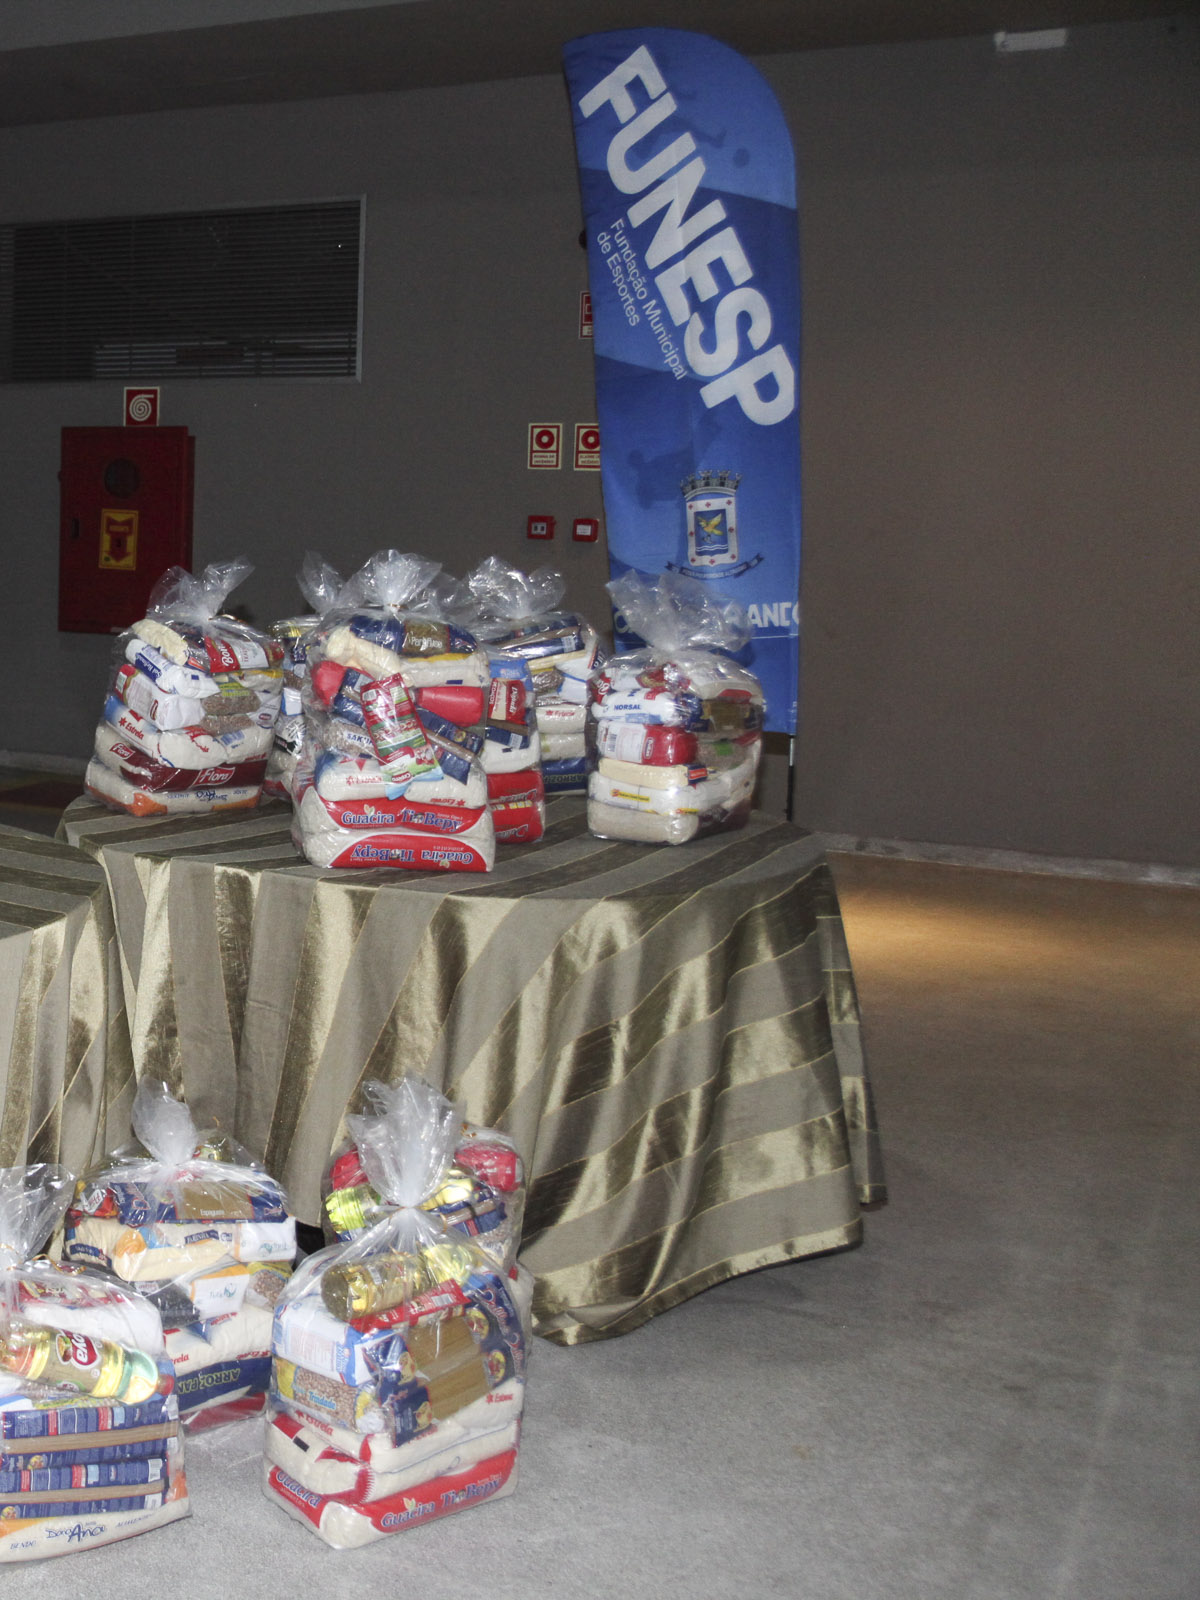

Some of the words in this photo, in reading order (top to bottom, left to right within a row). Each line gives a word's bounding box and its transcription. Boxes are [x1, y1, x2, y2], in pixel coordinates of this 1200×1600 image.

[579, 44, 795, 426] FUNESP
[597, 231, 611, 254] de
[606, 252, 640, 327] Esportes
[610, 218, 648, 300] Fundação
[642, 298, 688, 381] Municipal
[124, 722, 145, 740] Estrela
[200, 768, 229, 783] Flora
[341, 812, 395, 825] Guacira
[421, 849, 474, 865] Guacira
[71, 1333, 88, 1363] oya
[199, 1368, 240, 1389] ARROZ
[308, 1391, 337, 1411] Trindade
[276, 1470, 322, 1508] Guacira
[381, 1501, 436, 1527] Guacira
